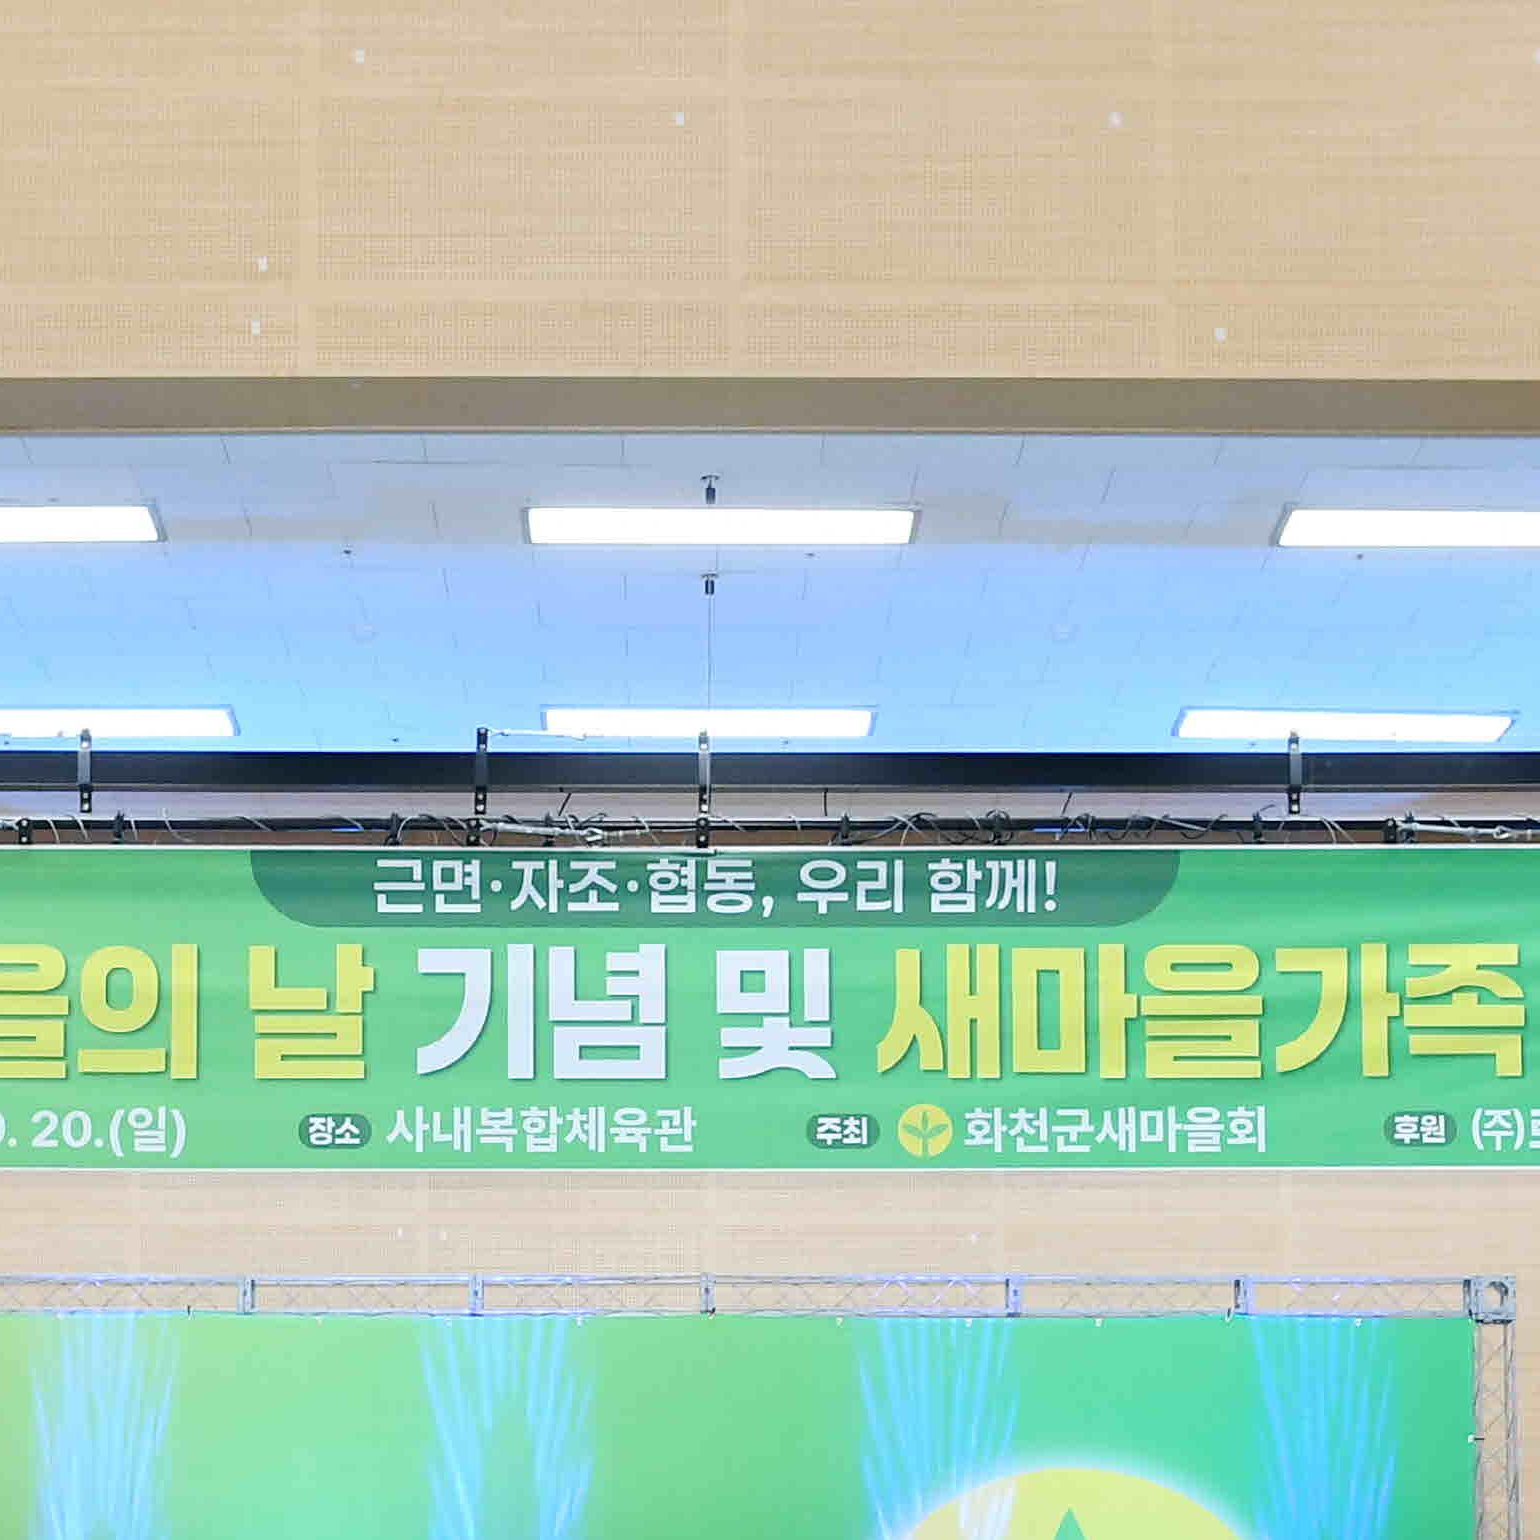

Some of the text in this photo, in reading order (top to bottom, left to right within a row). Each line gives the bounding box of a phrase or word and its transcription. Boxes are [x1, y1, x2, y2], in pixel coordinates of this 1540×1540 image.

[373, 857, 1059, 918] 근면·자조·협동, 우리 함께!
[248, 942, 376, 1080] 날
[415, 942, 667, 1080] 기념
[714, 946, 838, 1080] 및
[876, 942, 1527, 1080] 새마을가족
[29, 1105, 187, 1158] 20.(일)
[307, 1106, 697, 1154] 장소 사내복합체육관
[815, 1105, 1269, 1154] 주최 화천군새마을회
[1393, 1113, 1447, 1147] 후원
